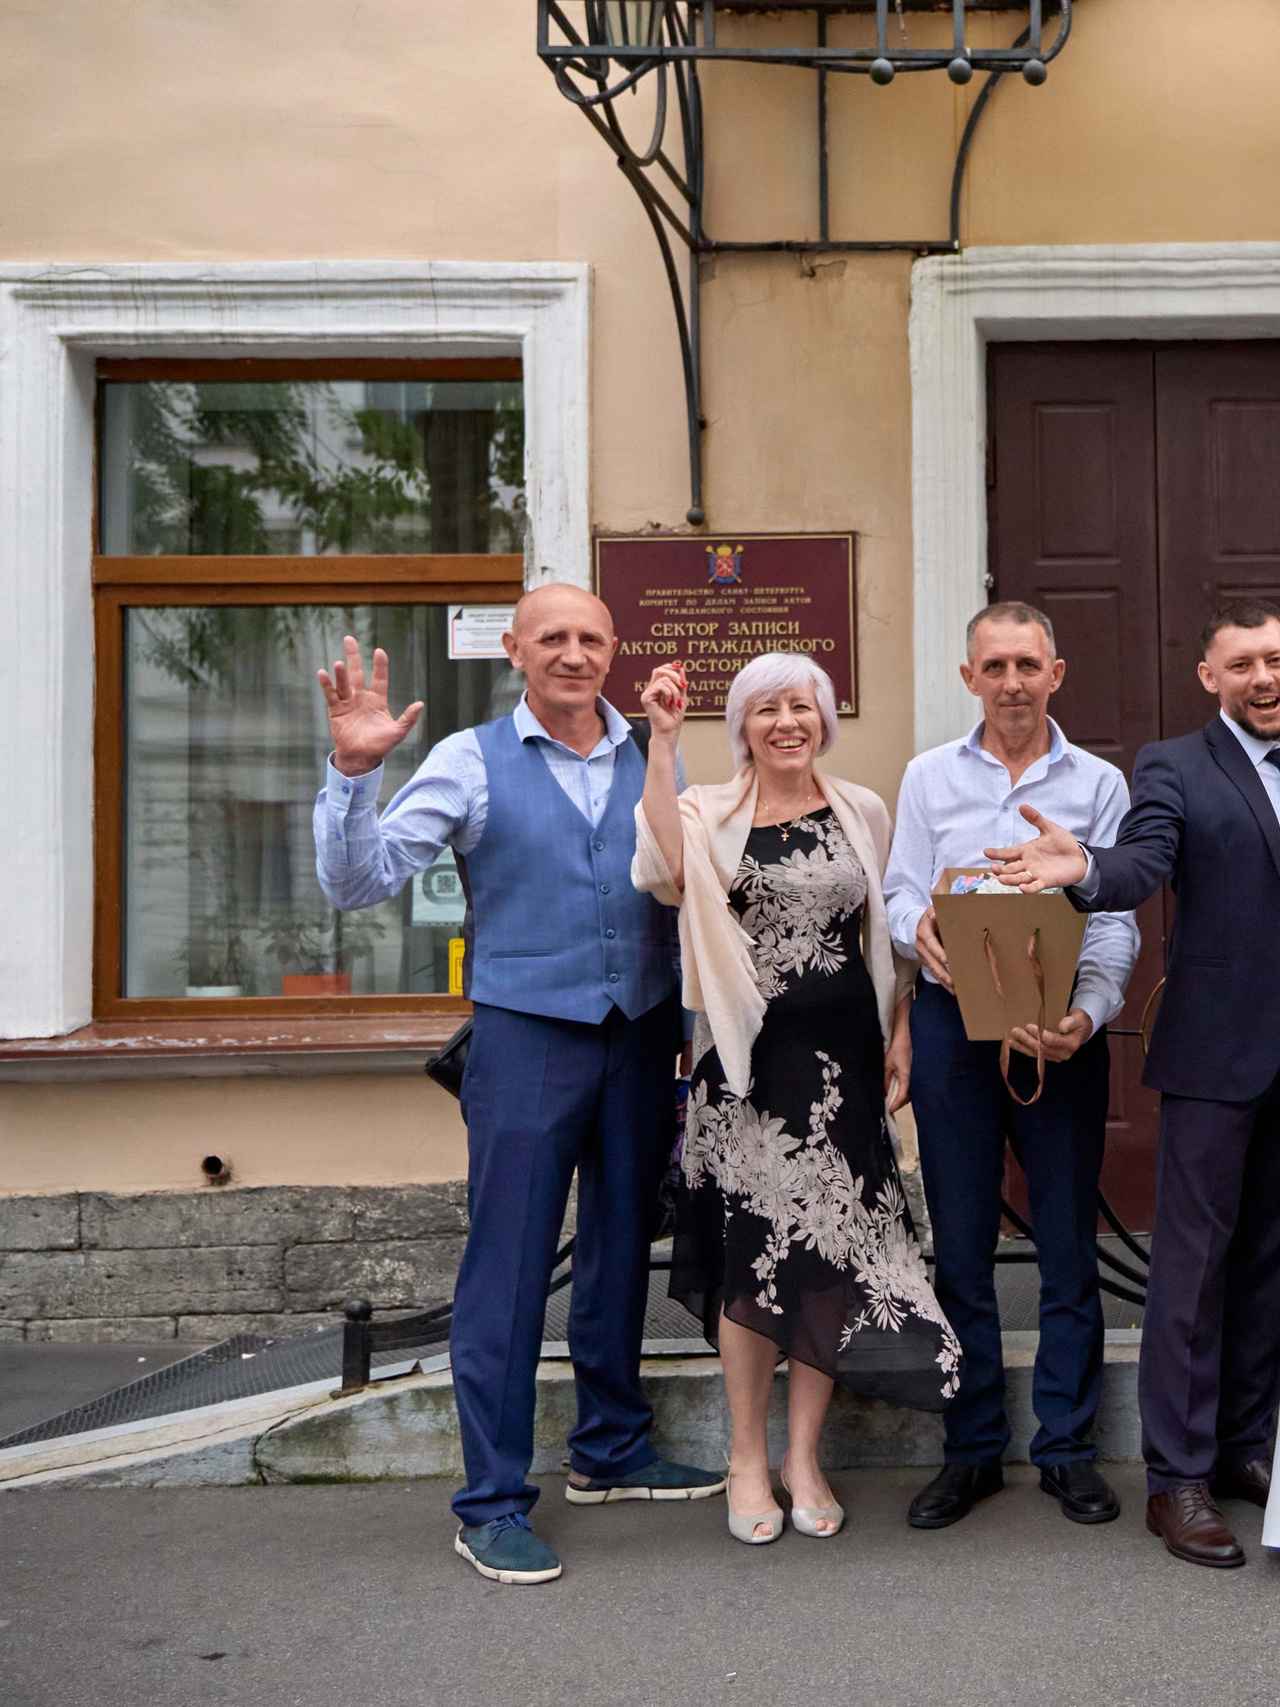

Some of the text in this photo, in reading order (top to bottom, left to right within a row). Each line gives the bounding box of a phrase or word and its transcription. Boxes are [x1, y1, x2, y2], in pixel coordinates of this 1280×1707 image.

[646, 588, 714, 596] ПРАВИТЕЛЬСТВО
[639, 599, 678, 607] КОМИТЕТ
[686, 598, 697, 606] ПО
[705, 598, 736, 606] ДЕЛАМ
[664, 606, 789, 615] ГРАЖДАНСКОГО СОСТОЯНИЯ
[651, 621, 800, 637] СЕКТОР ЗАПИСИ
[619, 639, 835, 655] АКТОВ ГРАЖДАНСКОГО
